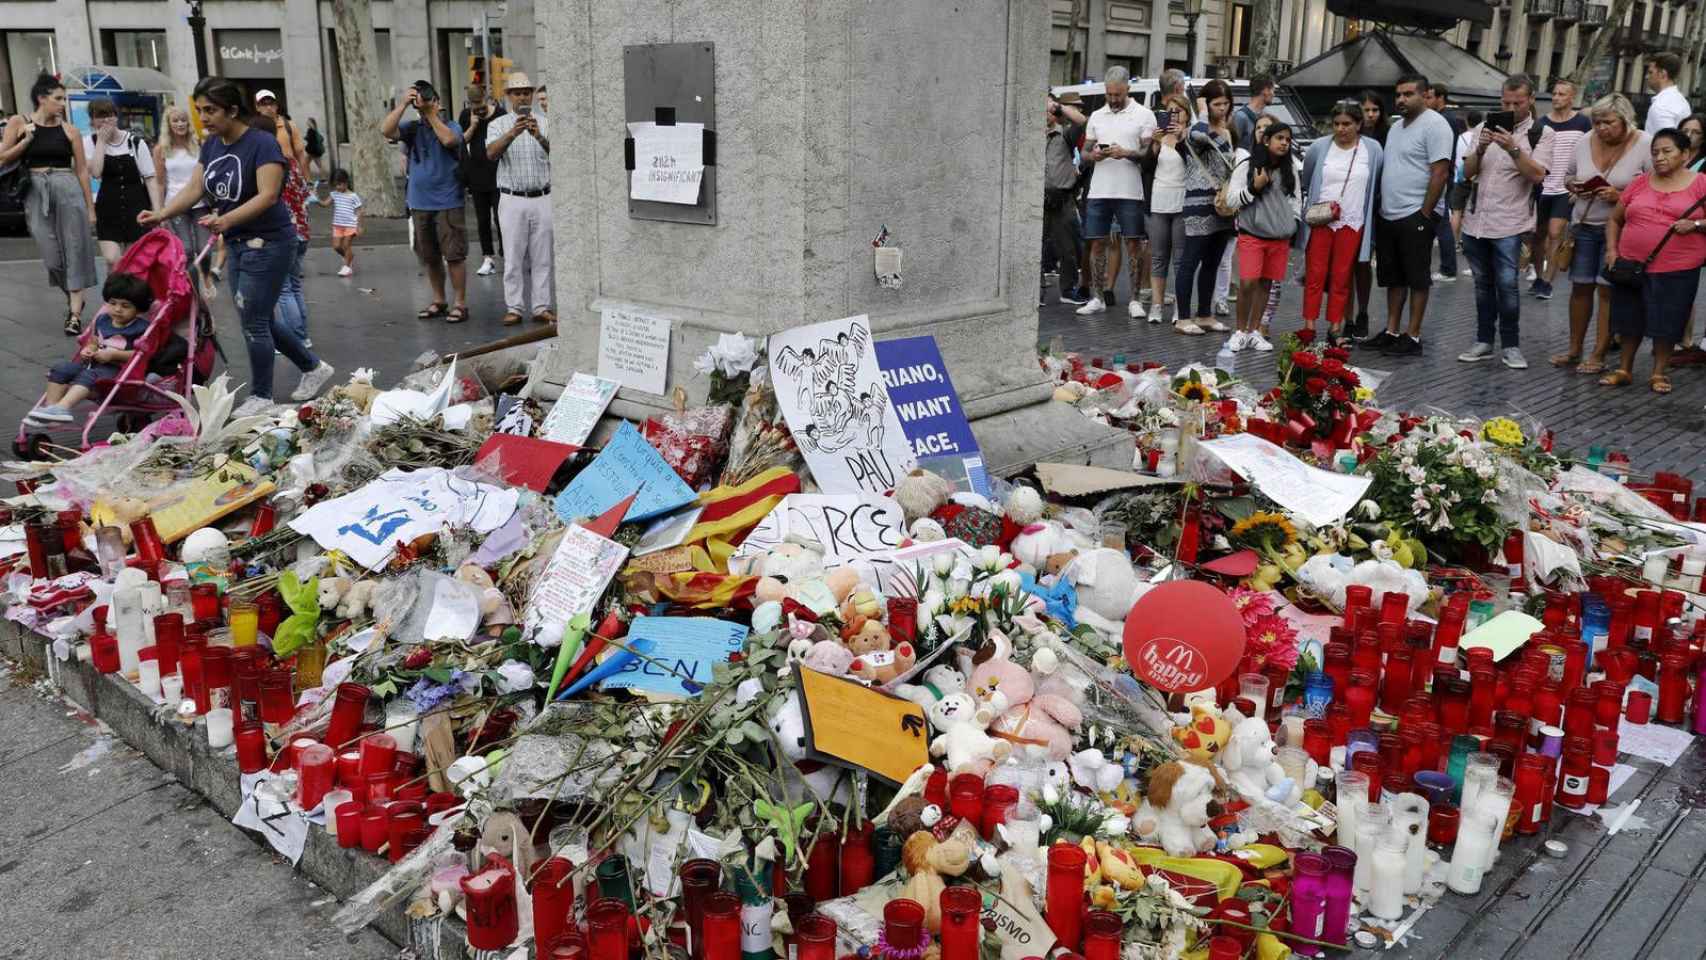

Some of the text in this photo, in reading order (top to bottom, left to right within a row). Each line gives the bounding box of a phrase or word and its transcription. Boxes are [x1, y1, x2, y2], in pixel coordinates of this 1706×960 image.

[896, 396, 952, 422] WANT
[844, 449, 896, 492] PAU
[1144, 644, 1201, 690] happy
